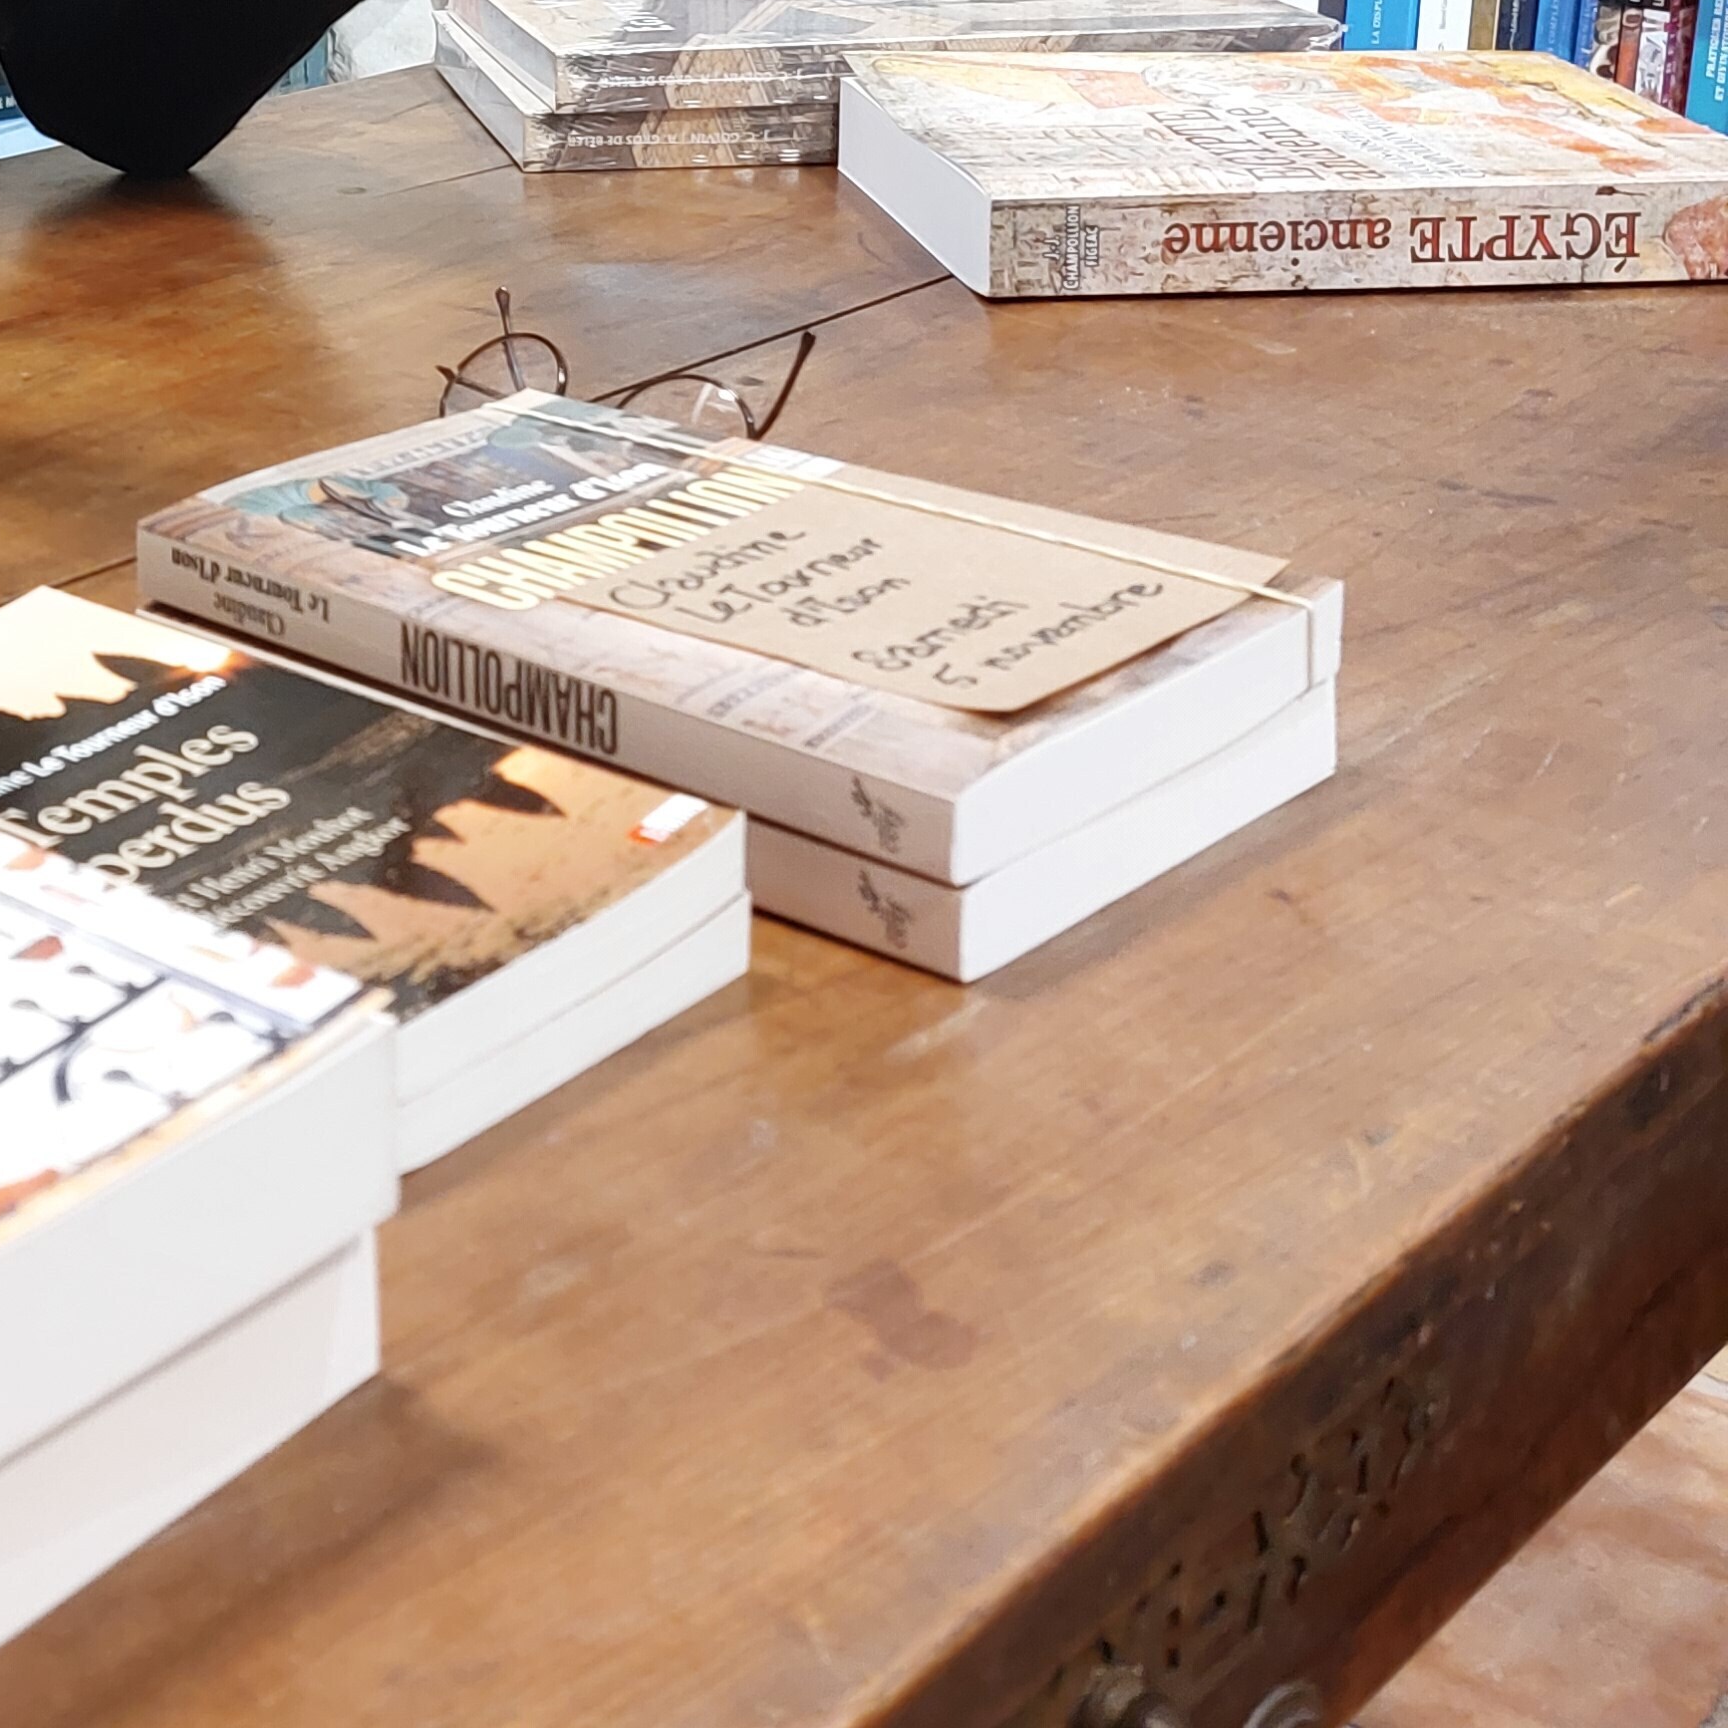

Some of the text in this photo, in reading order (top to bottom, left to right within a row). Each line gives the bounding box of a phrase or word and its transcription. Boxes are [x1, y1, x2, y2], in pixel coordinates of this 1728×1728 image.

[1371, 30, 1380, 44] LA
[1060, 204, 1082, 292] CHAMPOLLION
[1082, 224, 1101, 268] FIGEAC
[1160, 209, 1642, 271] ÉGYPTE ancienne
[441, 477, 556, 519] Claudine
[442, 491, 572, 546] Tourneur
[223, 562, 305, 614] Tourneur
[608, 526, 807, 611] Claudine
[213, 592, 286, 639] Claudine
[934, 580, 1166, 690] 5 novembre
[401, 621, 618, 756] CHAMPOLLION
[61, 696, 156, 768] Tourneur
